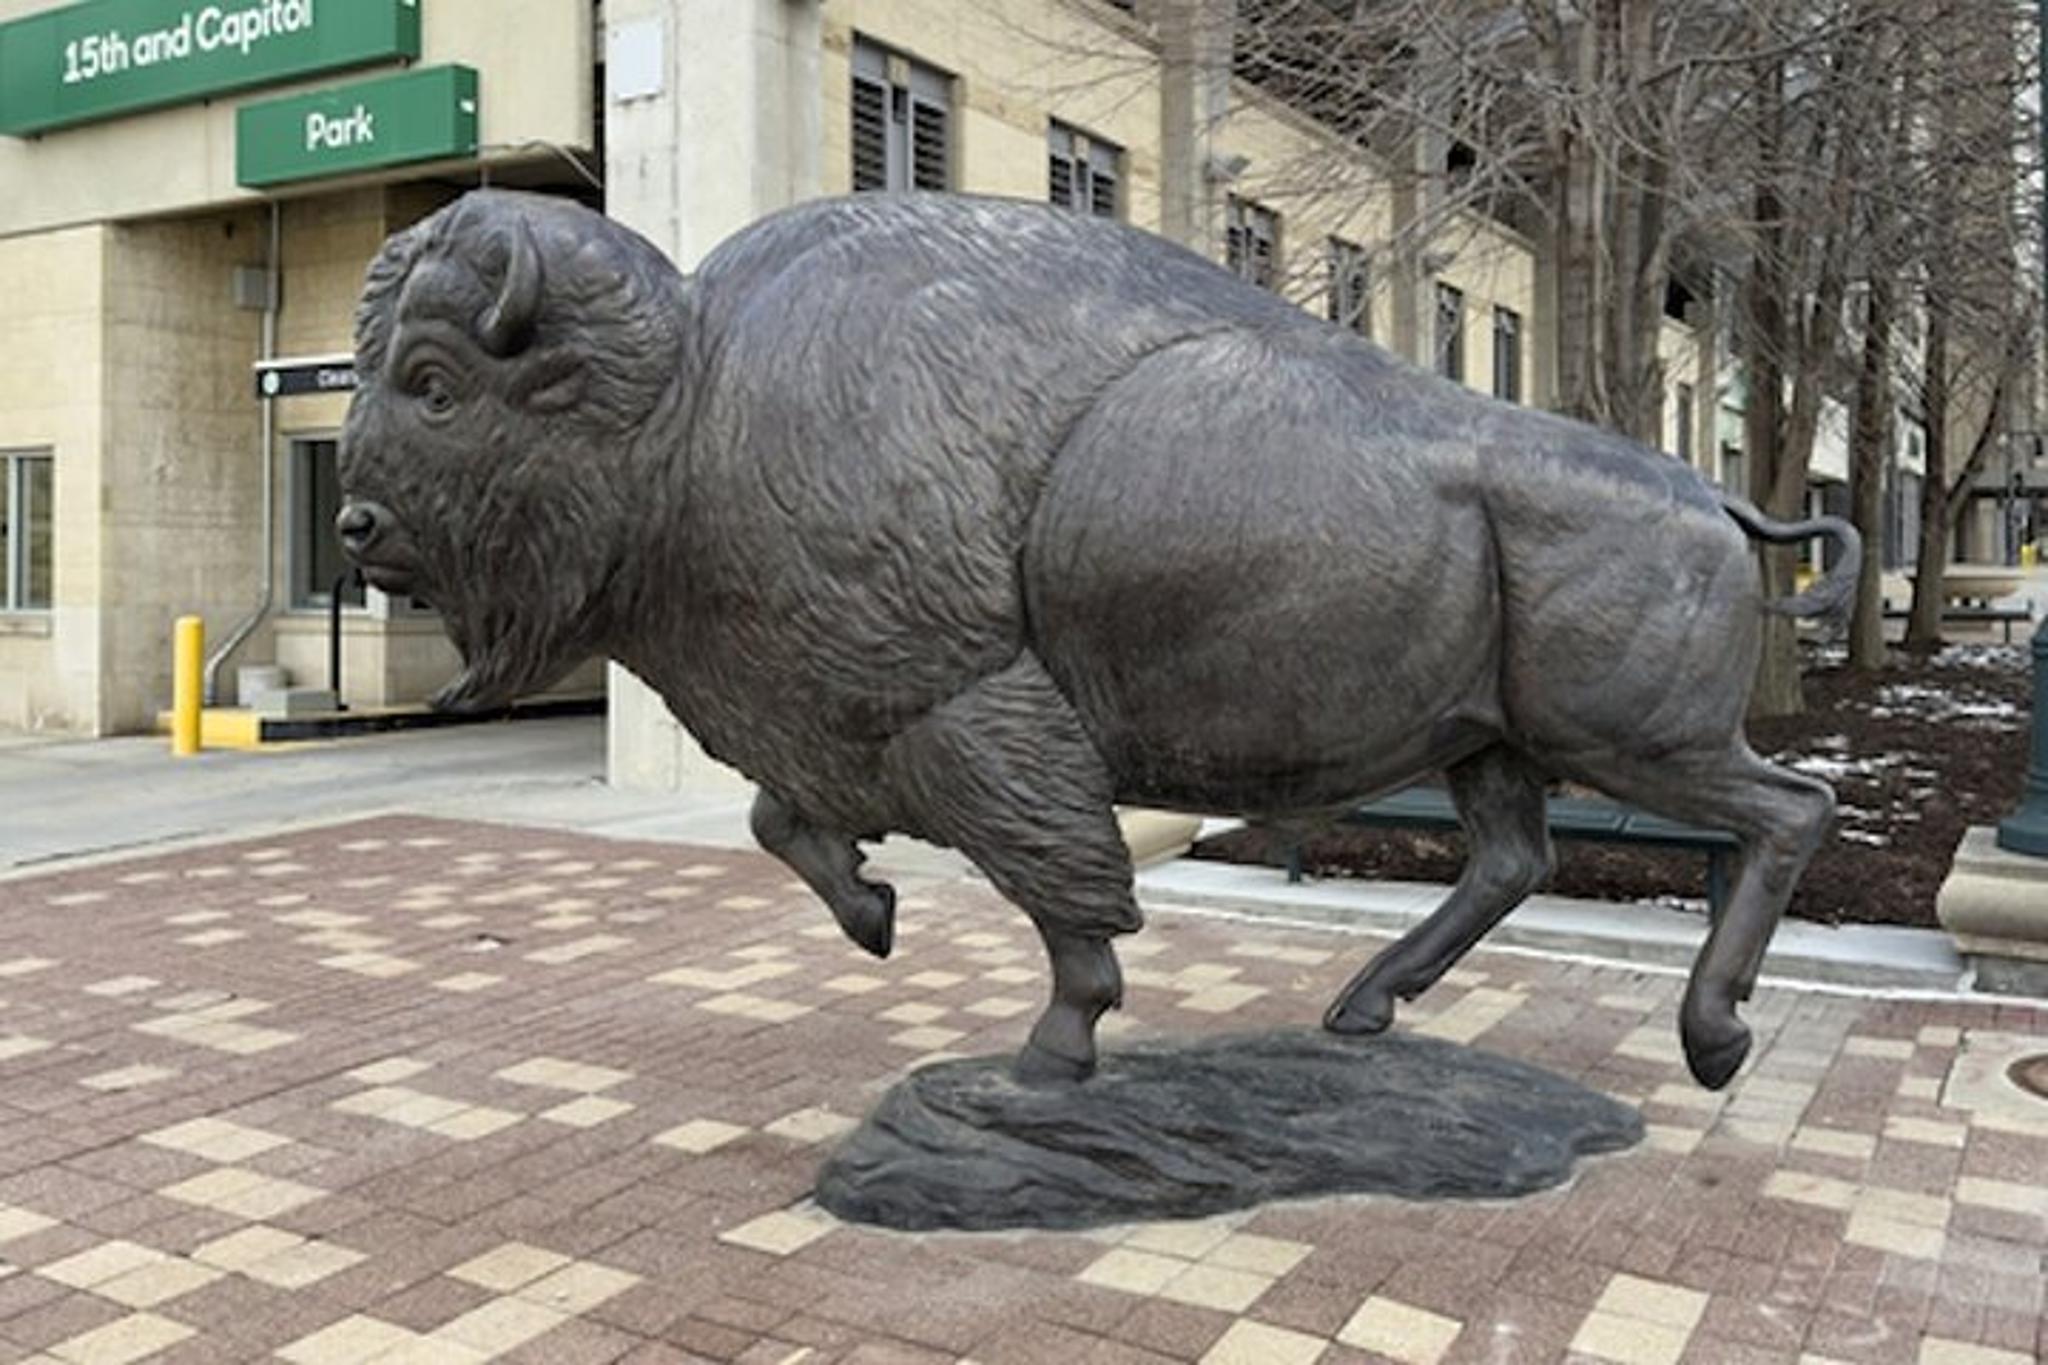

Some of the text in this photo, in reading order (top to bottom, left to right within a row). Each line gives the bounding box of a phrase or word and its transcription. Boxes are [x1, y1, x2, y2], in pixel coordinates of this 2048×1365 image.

[63, 0, 313, 82] 15th and Capitol
[307, 105, 373, 151] Park
